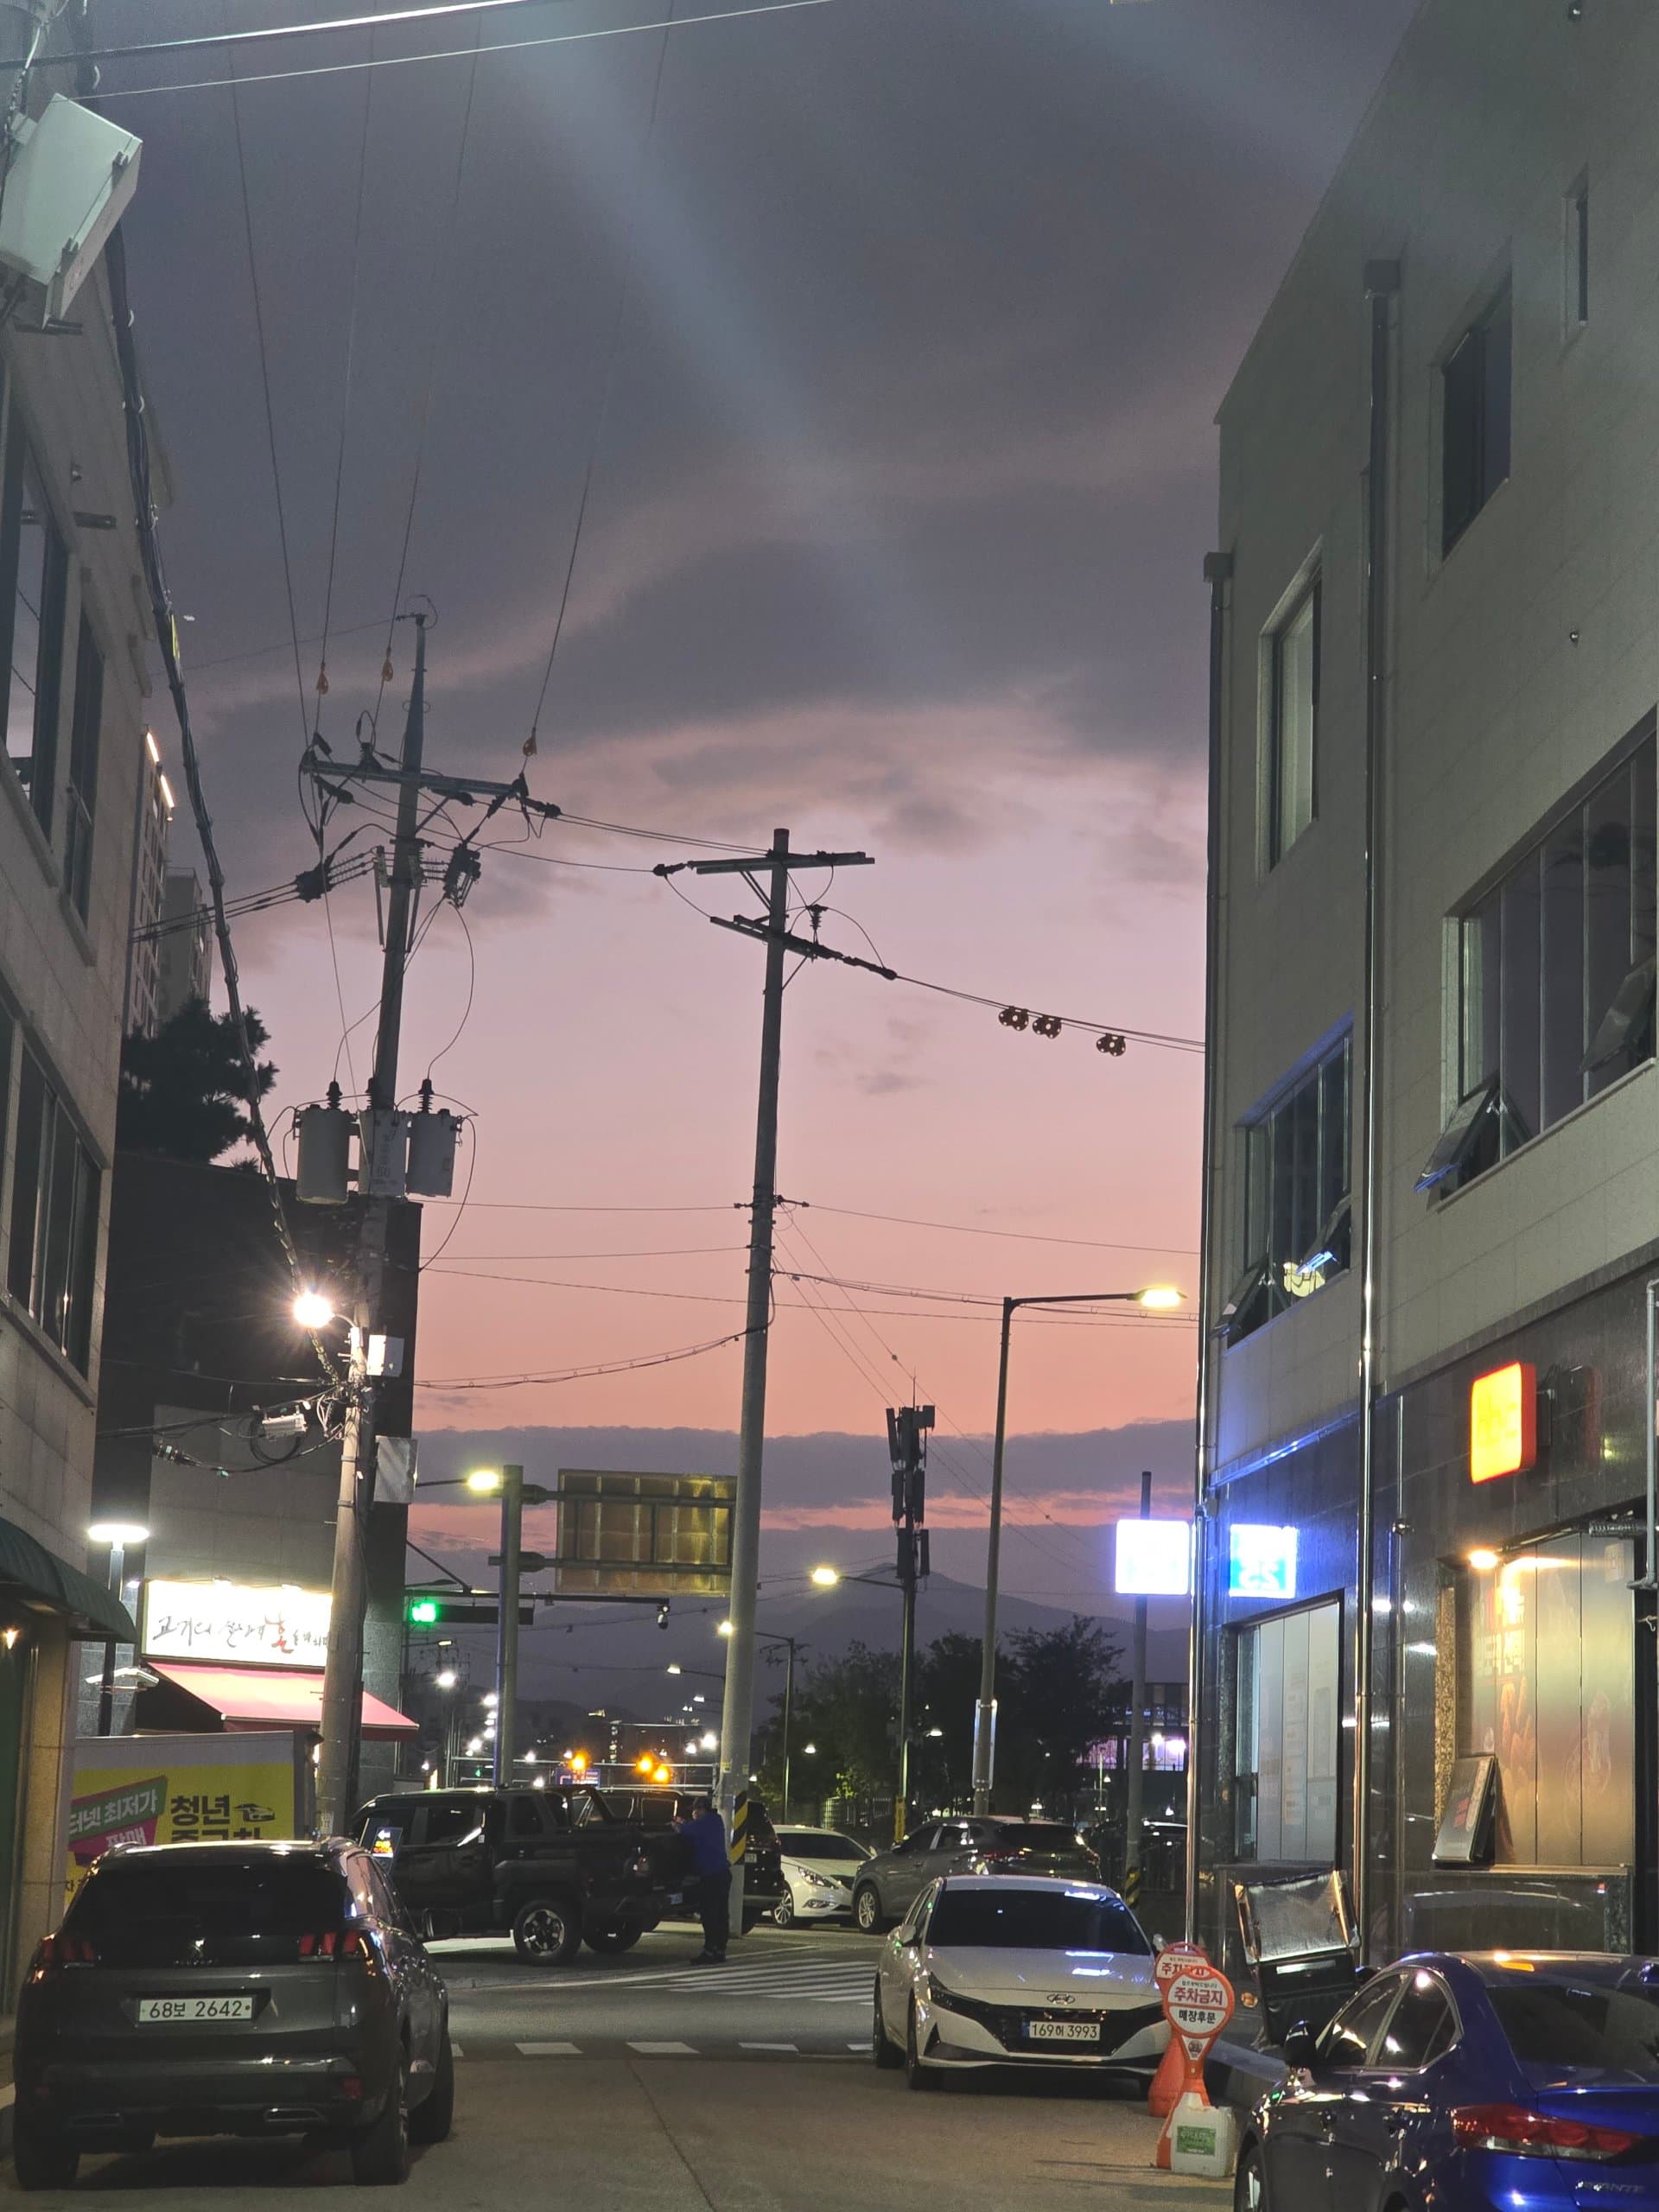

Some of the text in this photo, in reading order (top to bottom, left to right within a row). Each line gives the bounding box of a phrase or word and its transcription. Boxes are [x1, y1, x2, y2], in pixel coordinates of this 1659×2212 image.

[105, 1789, 157, 1824] 최저가
[171, 1795, 231, 1827] 청년
[1174, 1986, 1224, 2005] 주차금지
[149, 2000, 242, 2018] 68보 2642
[1179, 2009, 1216, 2024] 매장후문
[1067, 2024, 1097, 2038] 3993
